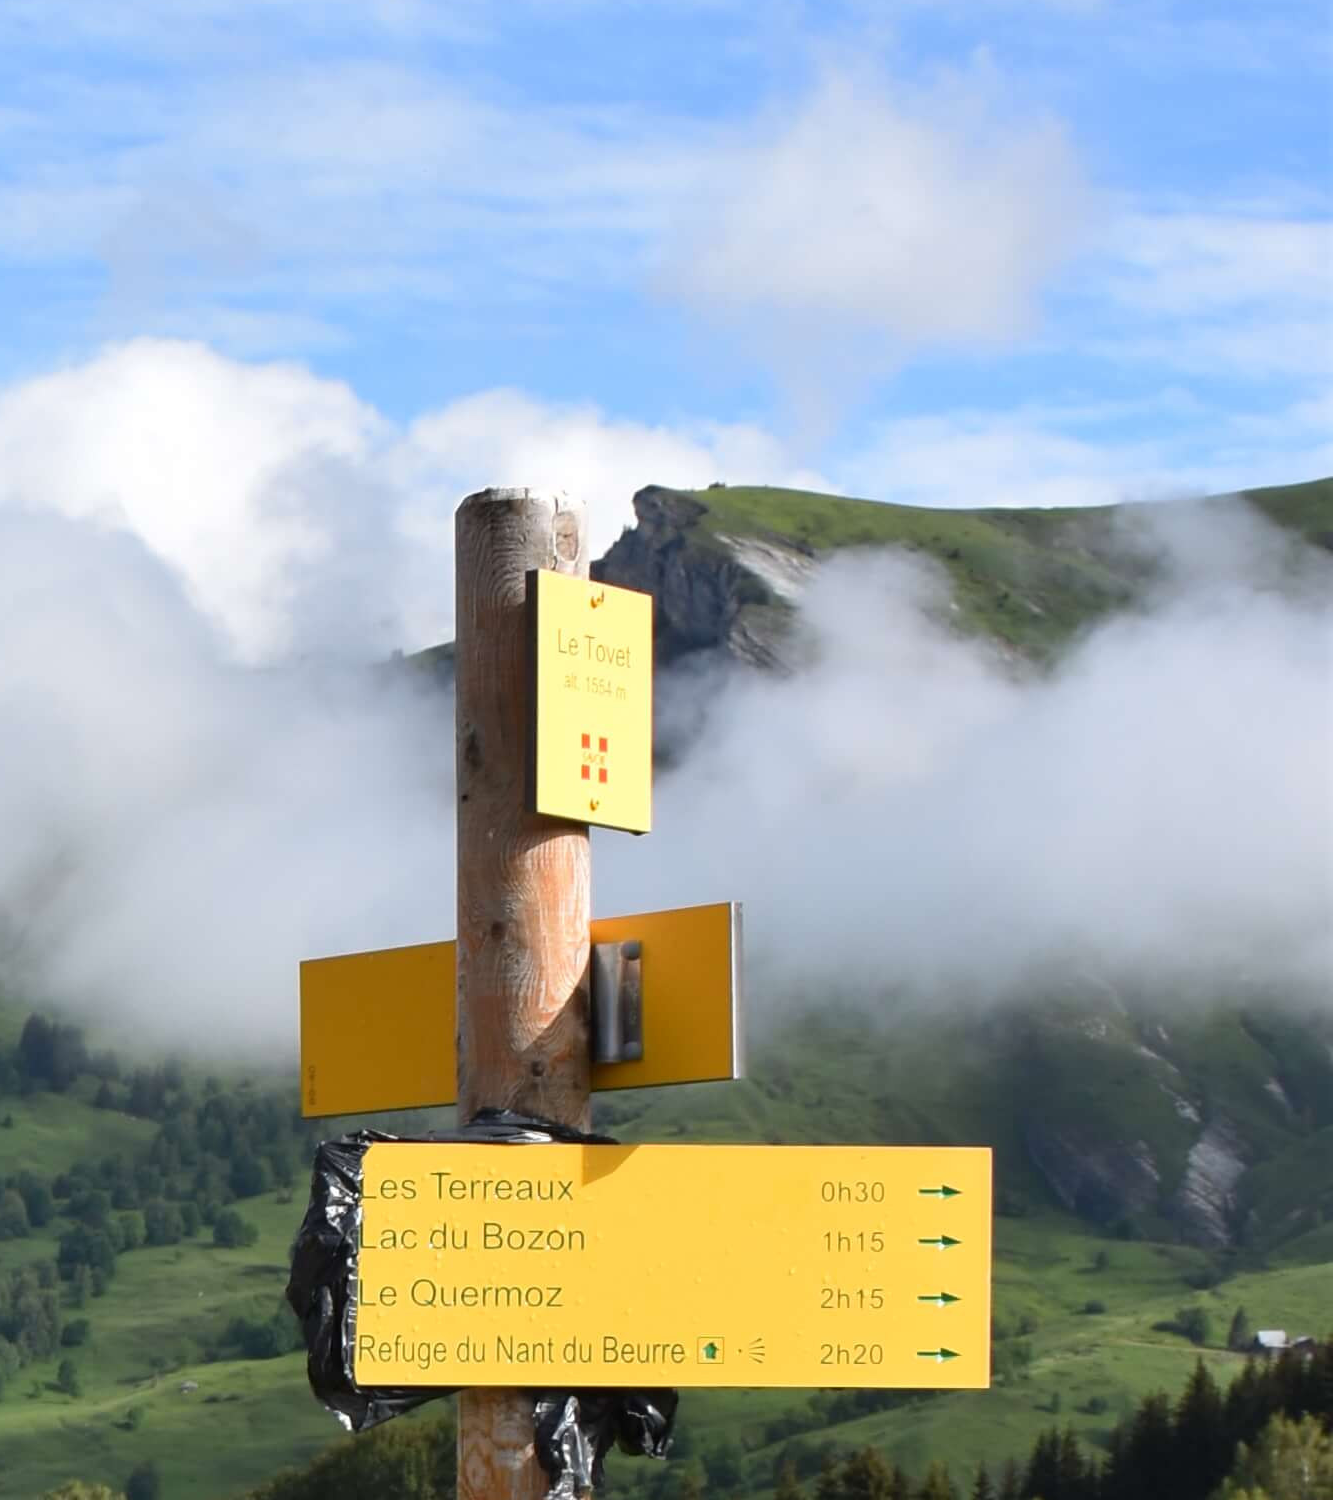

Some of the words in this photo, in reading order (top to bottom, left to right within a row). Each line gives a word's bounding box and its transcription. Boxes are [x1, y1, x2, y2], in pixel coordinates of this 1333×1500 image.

[557, 627, 579, 657] Le
[584, 634, 632, 669] Tovet
[360, 1172, 417, 1200] Les
[430, 1171, 574, 1201] Terreaux
[821, 1181, 885, 1203] 0h30
[359, 1222, 418, 1250] Lac
[429, 1222, 469, 1250] du
[482, 1222, 586, 1251] Bozon
[823, 1231, 885, 1253] 1h15
[359, 1279, 398, 1307] Le
[410, 1278, 565, 1308] Quermoz
[820, 1288, 884, 1309] 2h15
[358, 1334, 448, 1370] Refuge
[456, 1335, 486, 1363] du
[496, 1335, 555, 1363] Nant
[562, 1335, 593, 1363] du
[602, 1335, 685, 1364] Beurre
[820, 1343, 884, 1365] 2h20
